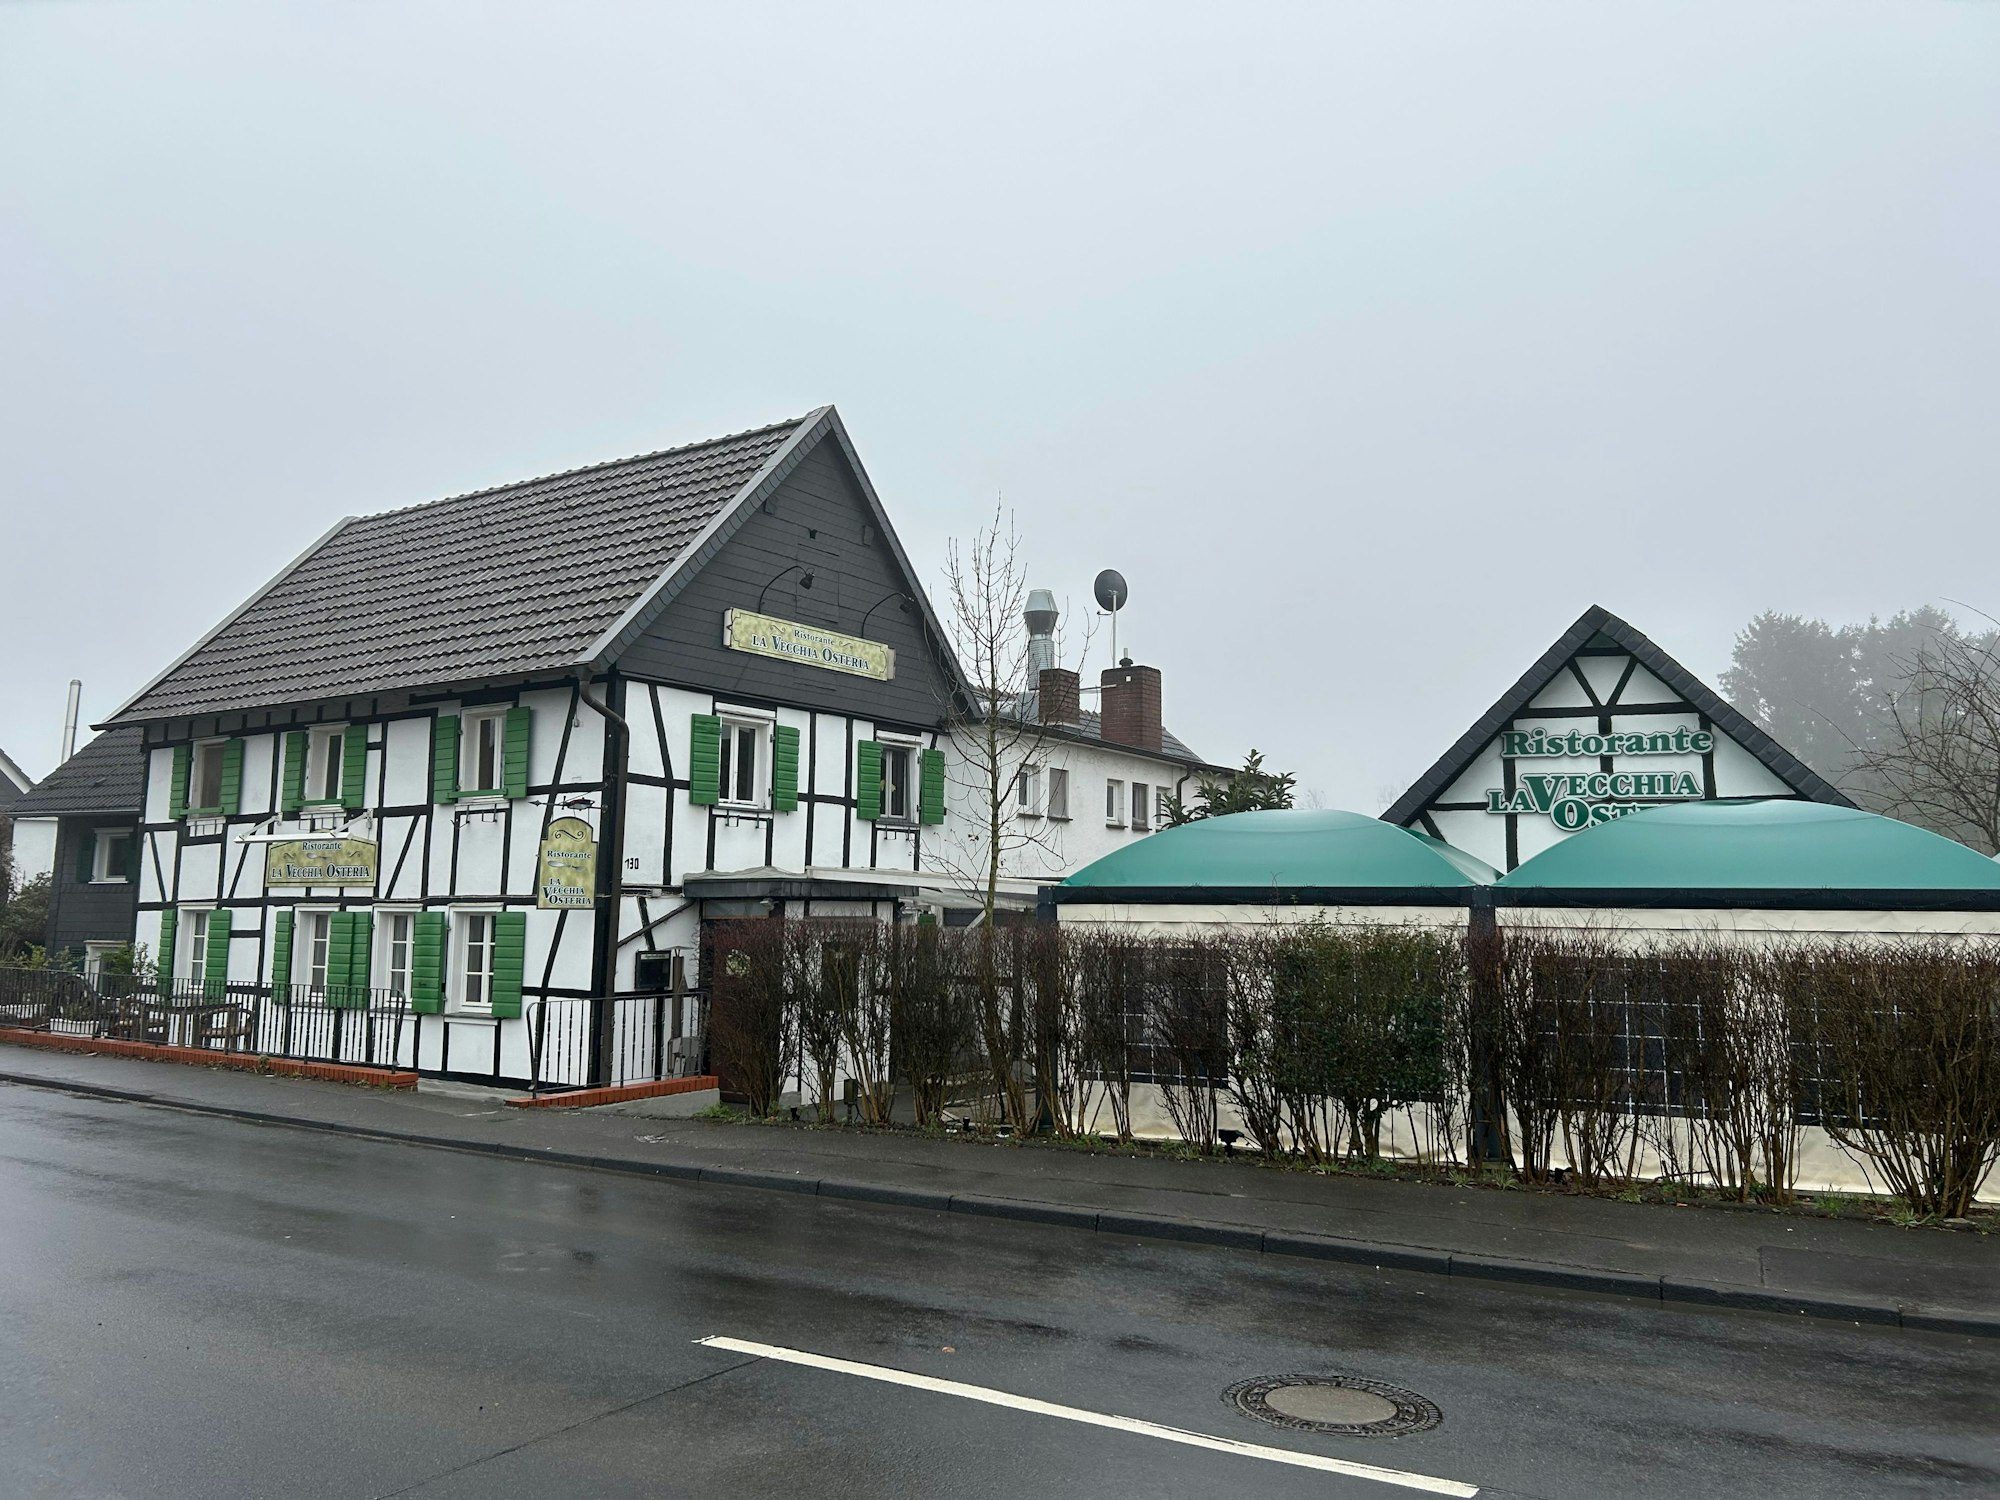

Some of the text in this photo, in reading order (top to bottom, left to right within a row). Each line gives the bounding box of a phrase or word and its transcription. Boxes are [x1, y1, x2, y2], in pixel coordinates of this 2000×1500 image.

[794, 629, 835, 646] Ristorante
[752, 635, 870, 670] LA VECCHIA OSTERIA
[1502, 727, 1713, 757] Ristorante
[1487, 772, 1702, 813] LA VECCHIA
[302, 841, 342, 851] Ristorante
[547, 850, 592, 859] Ristorante
[272, 863, 370, 878] LA VECCHIA OSTERIA
[624, 857, 640, 870] 130
[542, 886, 585, 899] VECCHIA
[549, 894, 591, 905] OSTERIA
